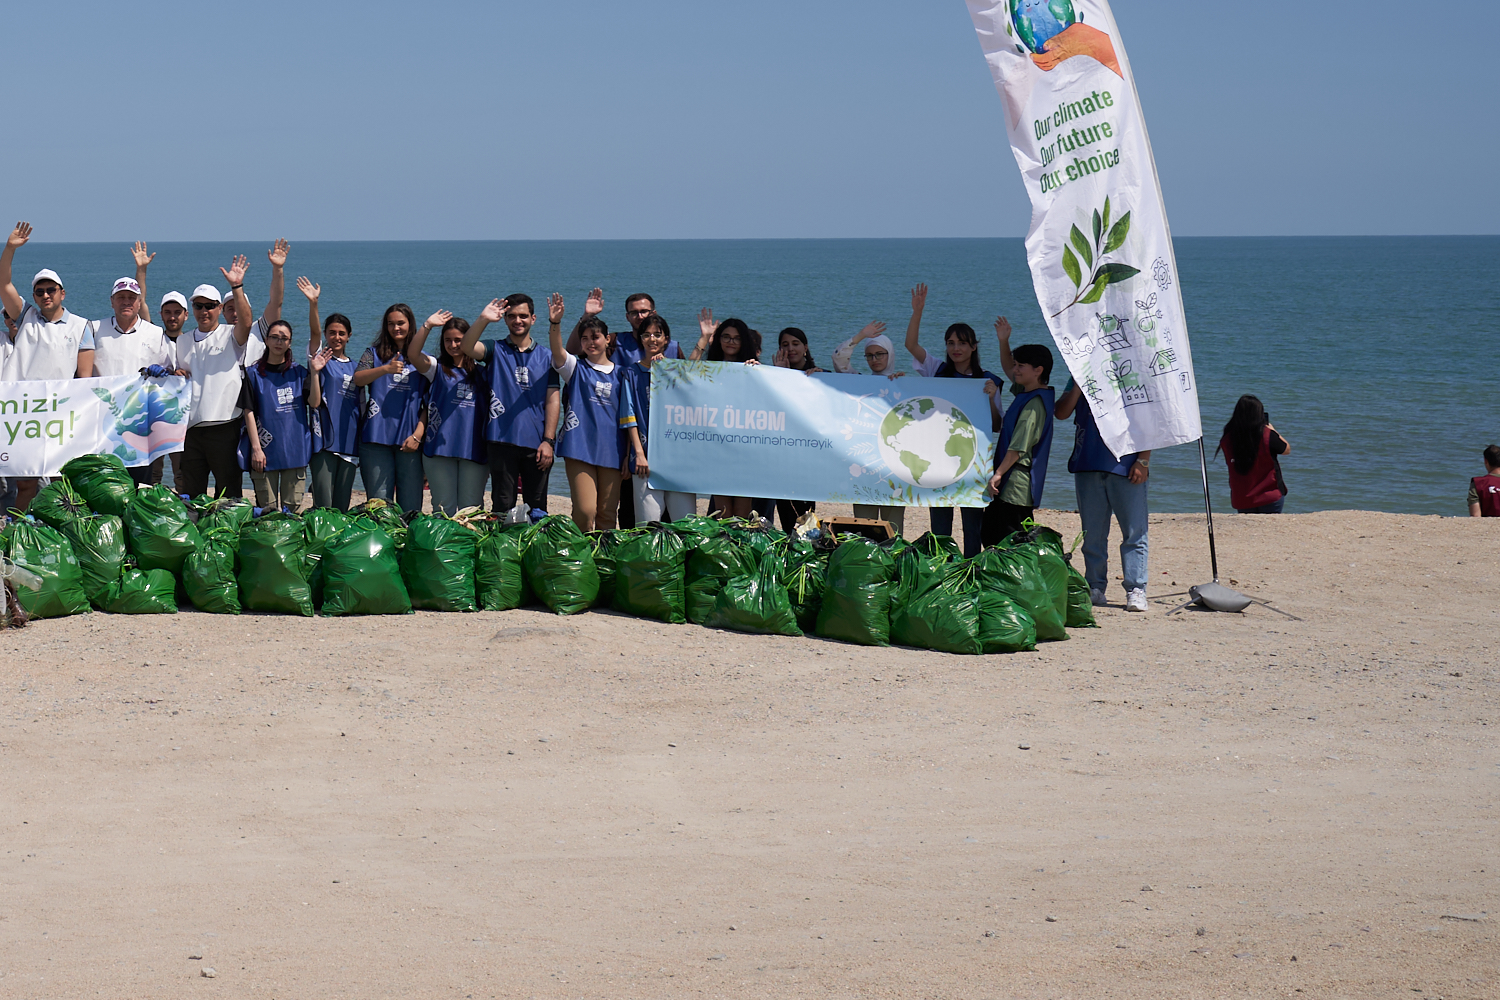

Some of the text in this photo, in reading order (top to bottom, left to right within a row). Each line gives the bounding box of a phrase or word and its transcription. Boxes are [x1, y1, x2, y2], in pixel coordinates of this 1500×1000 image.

[1034, 90, 1114, 141] Our climate
[1040, 121, 1113, 168] Our future
[1040, 148, 1120, 194] Our choice
[664, 404, 786, 432] TƏMİZ ÖLKƏM
